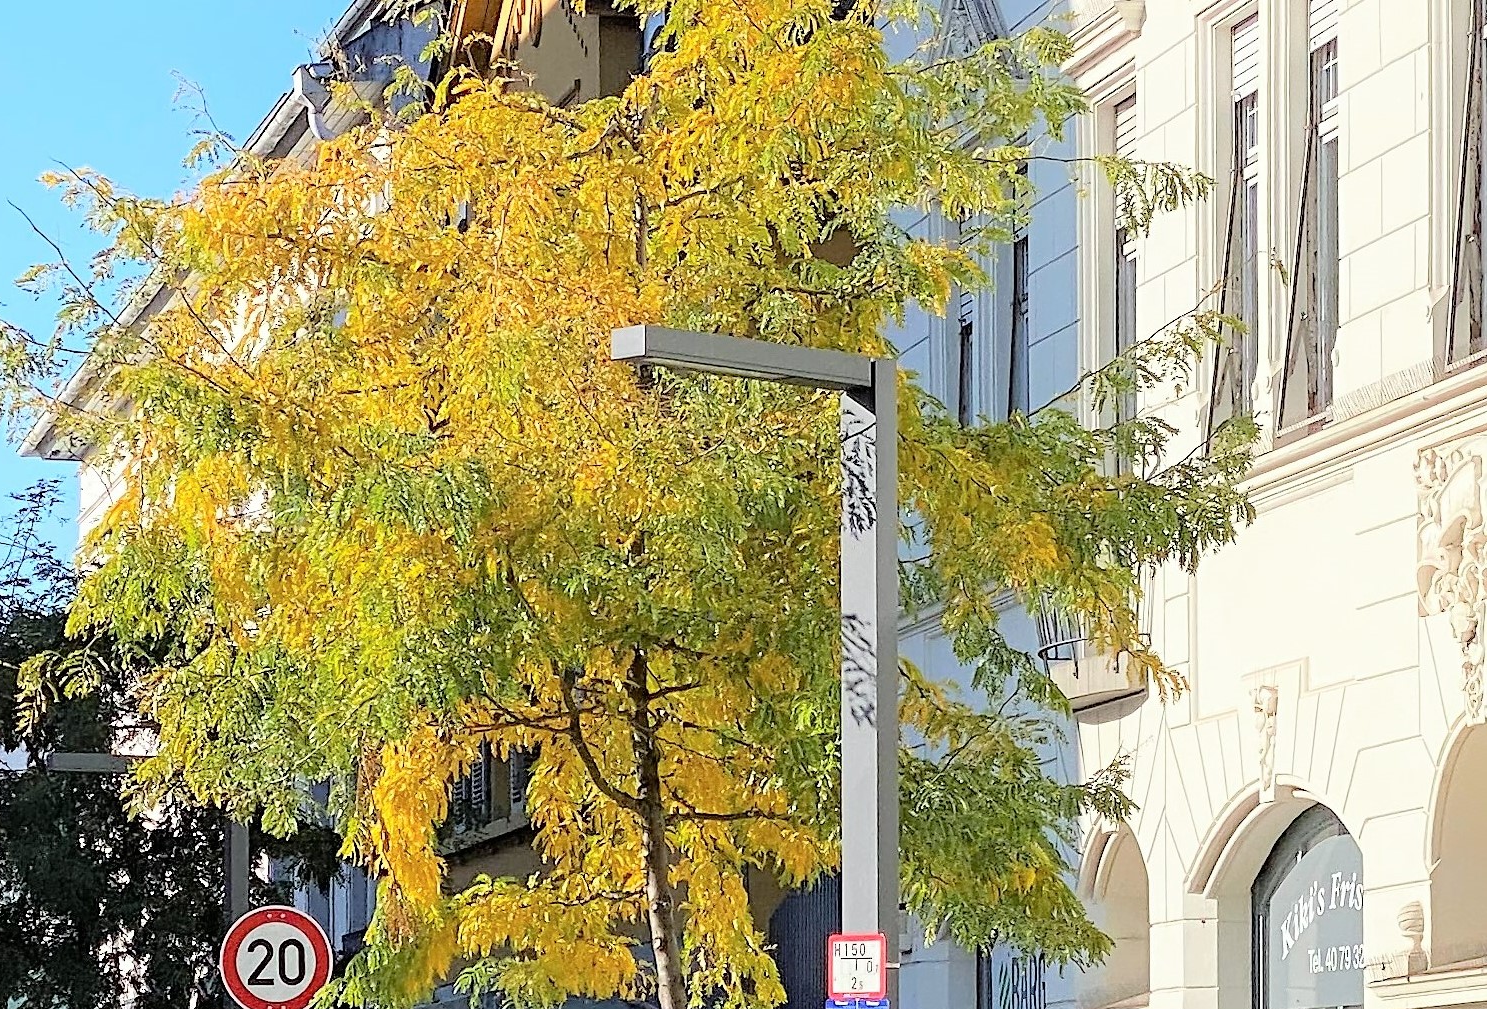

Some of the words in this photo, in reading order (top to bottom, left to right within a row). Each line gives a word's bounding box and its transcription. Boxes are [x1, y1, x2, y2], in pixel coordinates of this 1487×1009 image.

[1280, 880, 1326, 961] Kiki's
[1328, 871, 1364, 911] Fris
[247, 938, 306, 986] 20
[1307, 948, 1325, 974] Tel.
[1325, 946, 1338, 973] 40
[1338, 945, 1352, 971] 79
